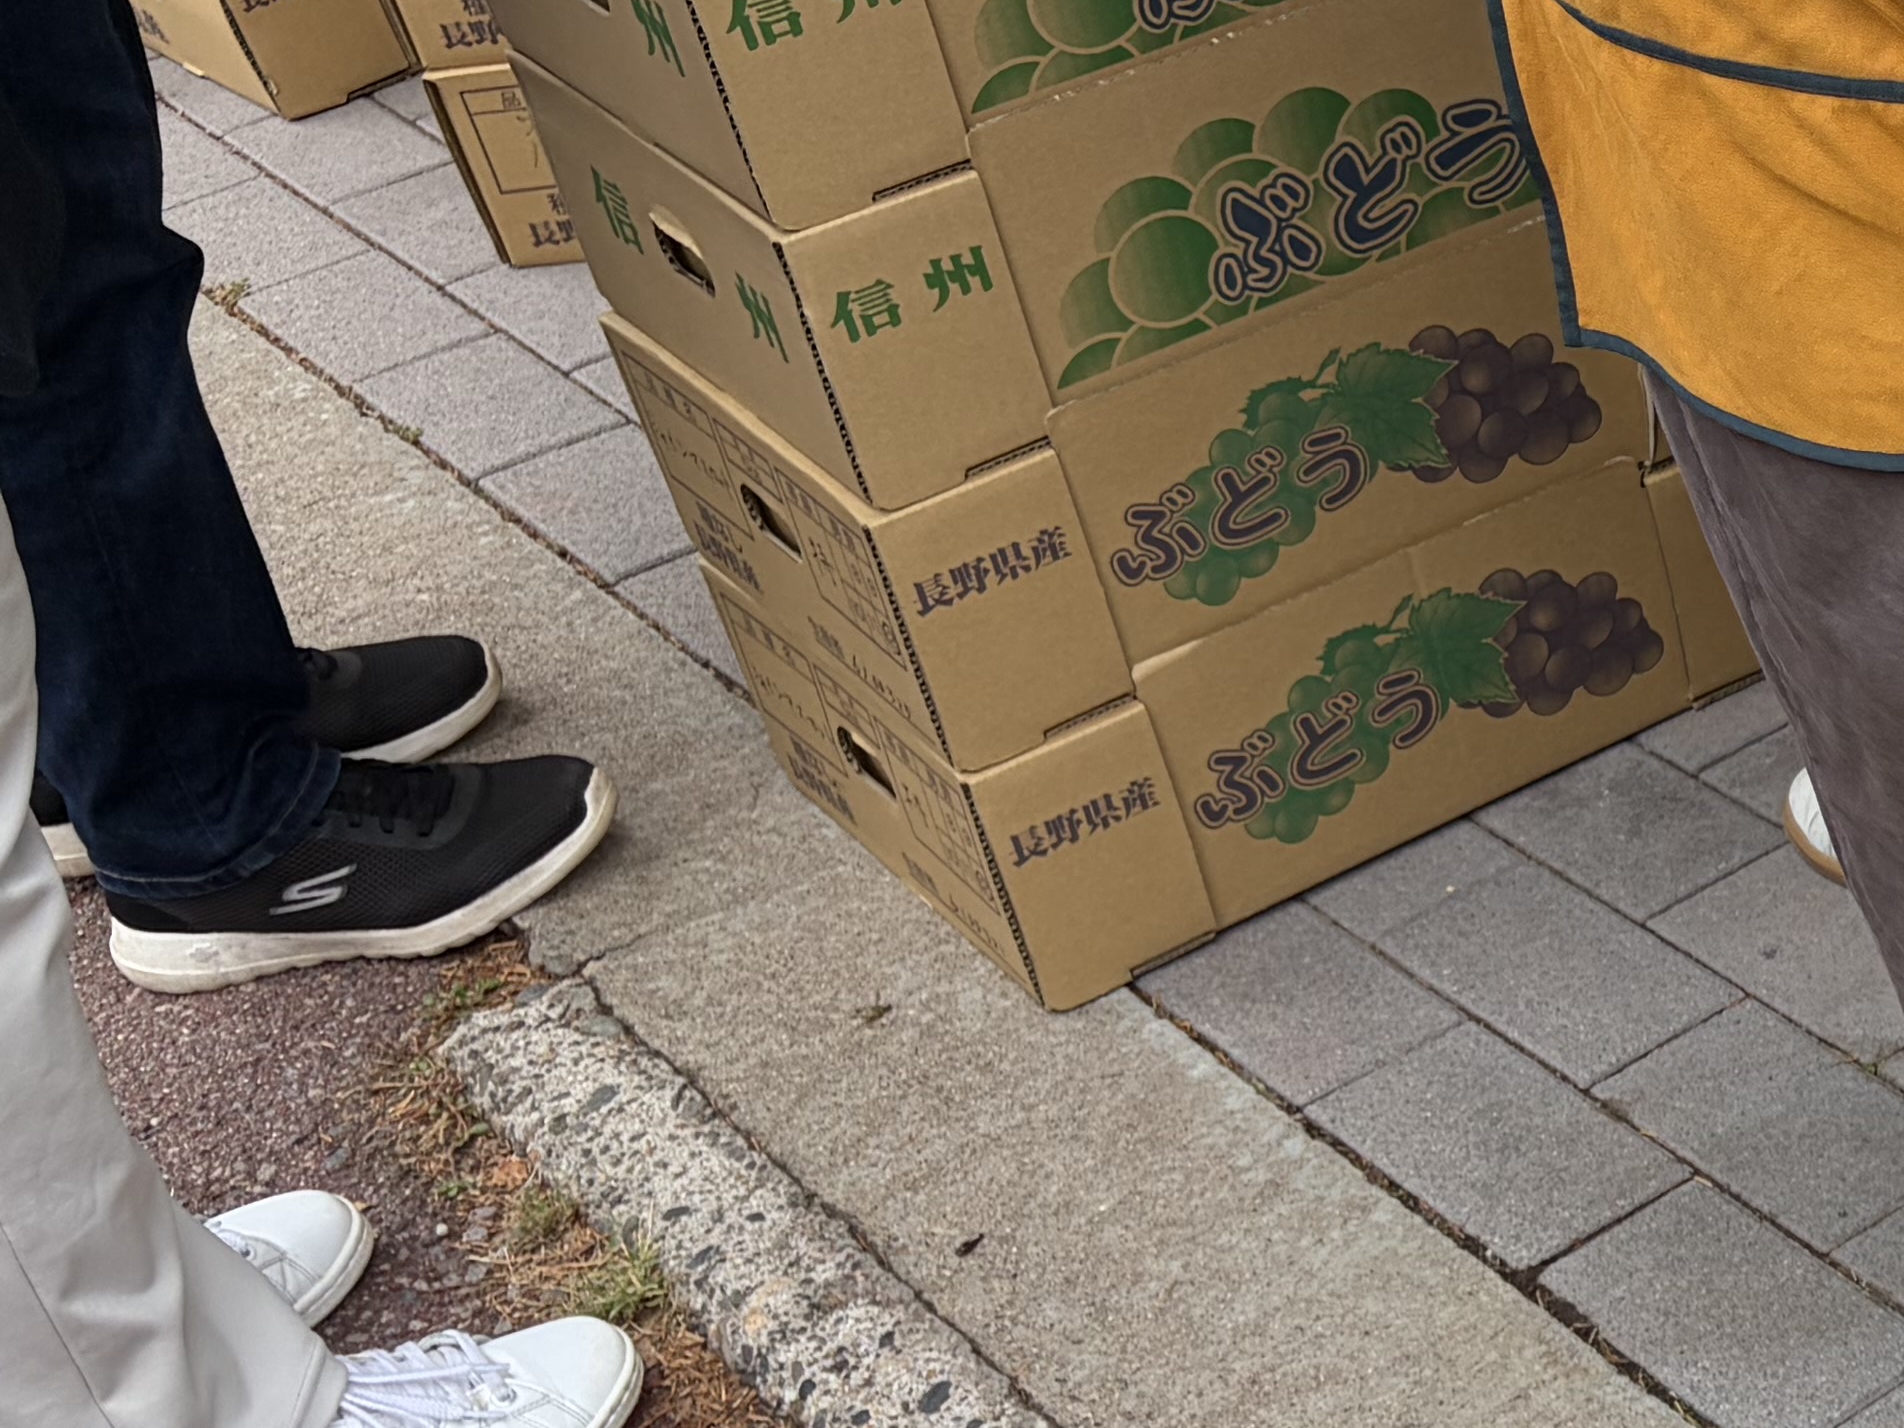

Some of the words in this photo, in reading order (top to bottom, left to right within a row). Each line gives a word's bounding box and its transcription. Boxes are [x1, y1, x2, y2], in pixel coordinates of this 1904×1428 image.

[590, 165, 789, 364] 信州
[1212, 99, 1532, 304] ぶどう
[830, 245, 994, 344] 信州
[911, 525, 1074, 617] 長野県産
[1110, 426, 1371, 586] ぶどう
[1009, 776, 1161, 867] 長野県産
[1194, 667, 1442, 830] ぶどう
